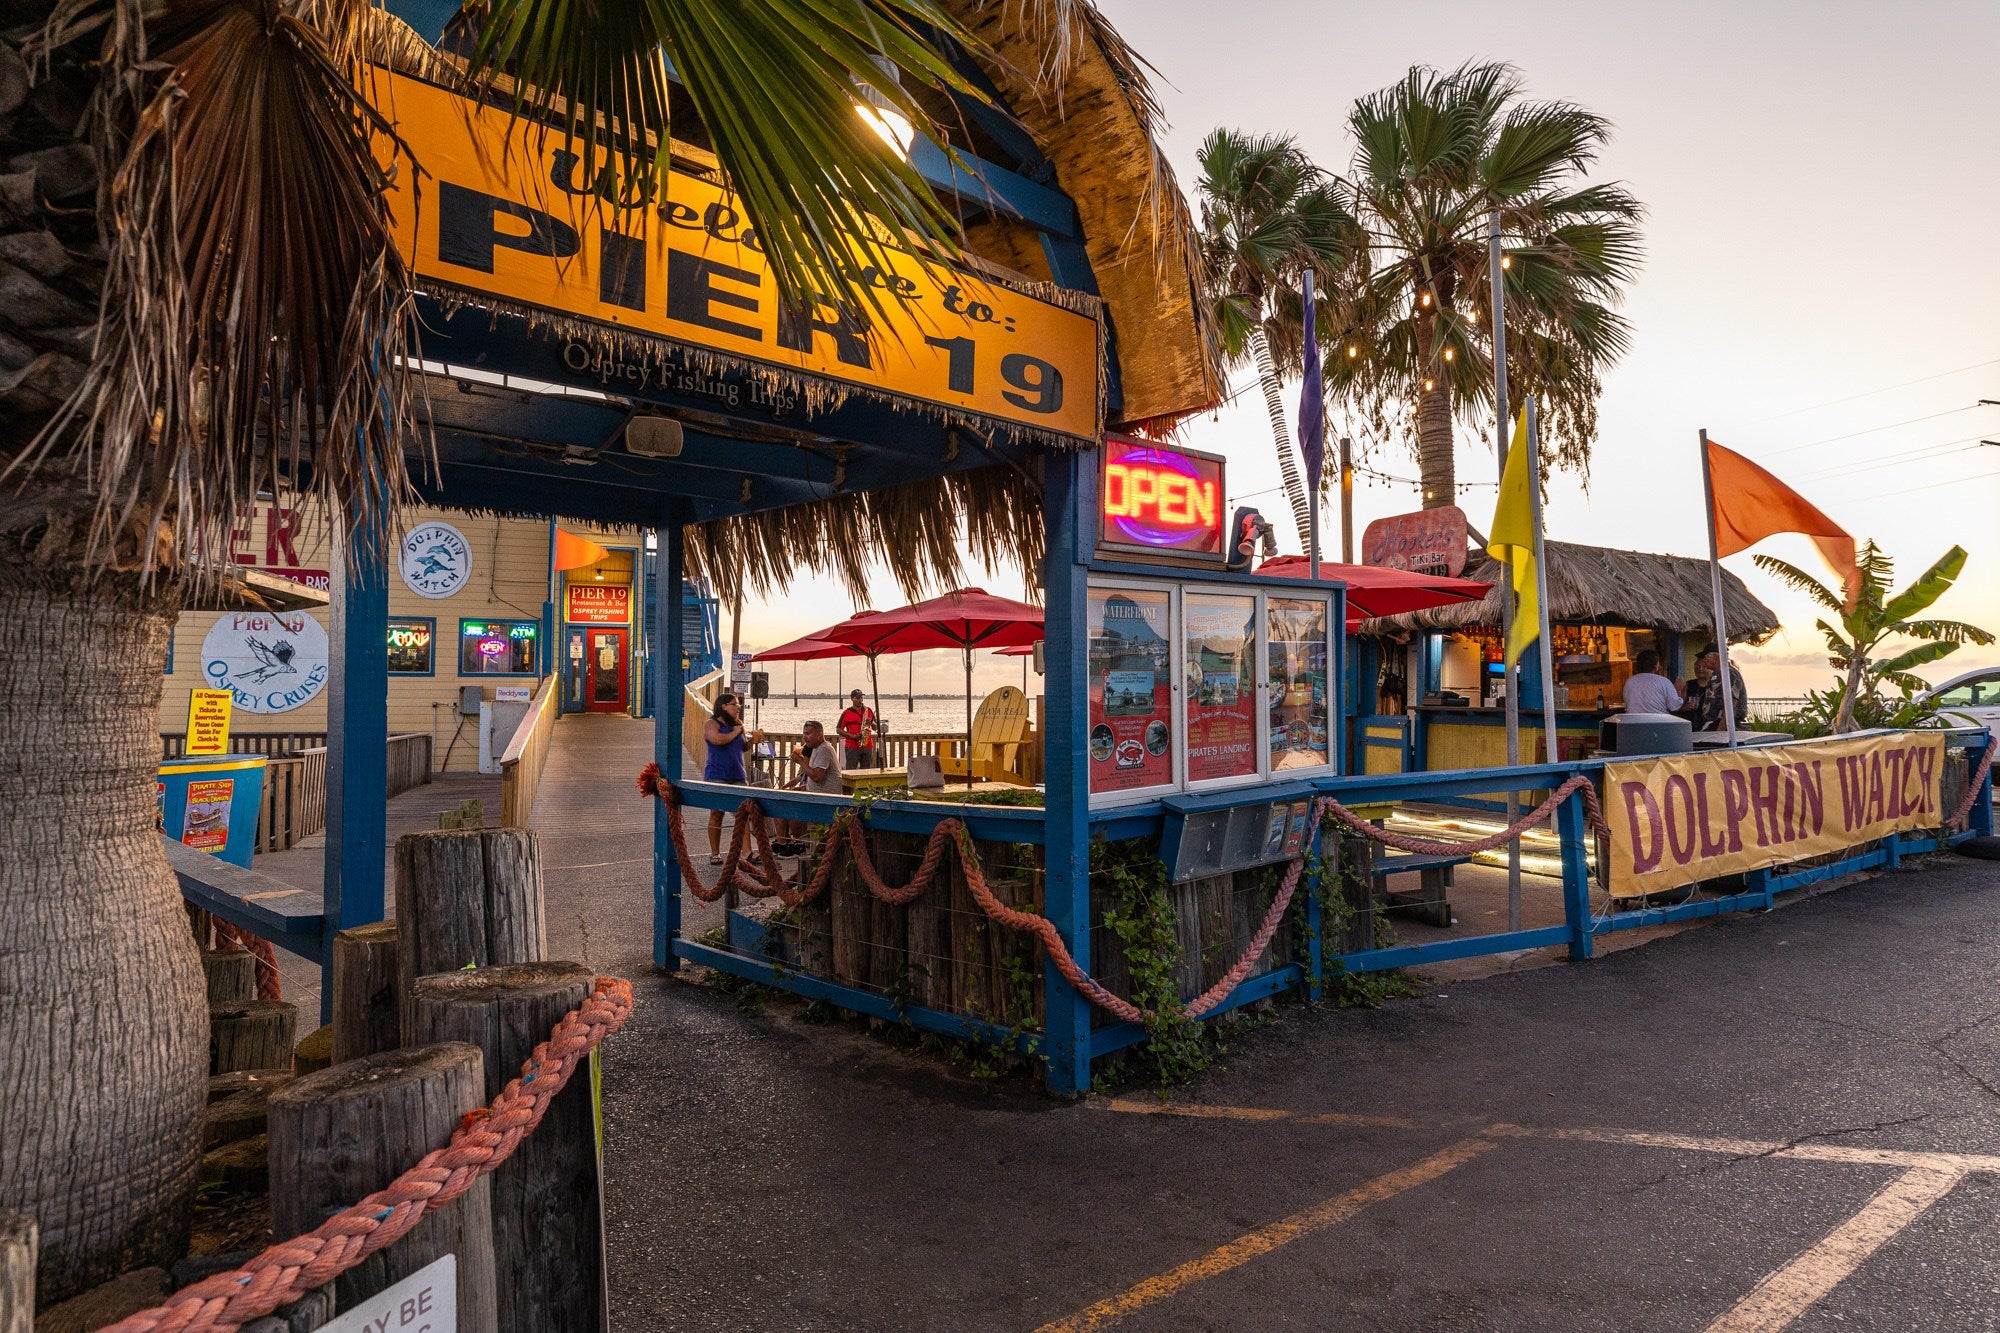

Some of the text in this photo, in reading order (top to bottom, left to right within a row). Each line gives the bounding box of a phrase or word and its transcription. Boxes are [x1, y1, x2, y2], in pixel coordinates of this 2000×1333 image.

[438, 179, 1064, 415] PIER 19
[943, 284, 1016, 333] to:
[563, 343, 651, 391] Osprey
[661, 362, 739, 406] Fishing
[1105, 463, 1214, 527] OPEN
[407, 530, 464, 556] DOLPHIN
[1431, 552, 1445, 563] Bar
[410, 570, 459, 591] WATCH
[571, 587, 627, 600] PIER 19
[232, 613, 275, 631] Pier
[1102, 605, 1156, 620] WATERFRONT
[510, 628, 535, 637] ATM
[480, 642, 504, 653] OPEN
[207, 660, 328, 709] OSPREY CRUISES
[1220, 743, 1250, 755] LANDING
[1620, 746, 1937, 875] DOLPHIN WATCH
[400, 1285, 433, 1328] BE
